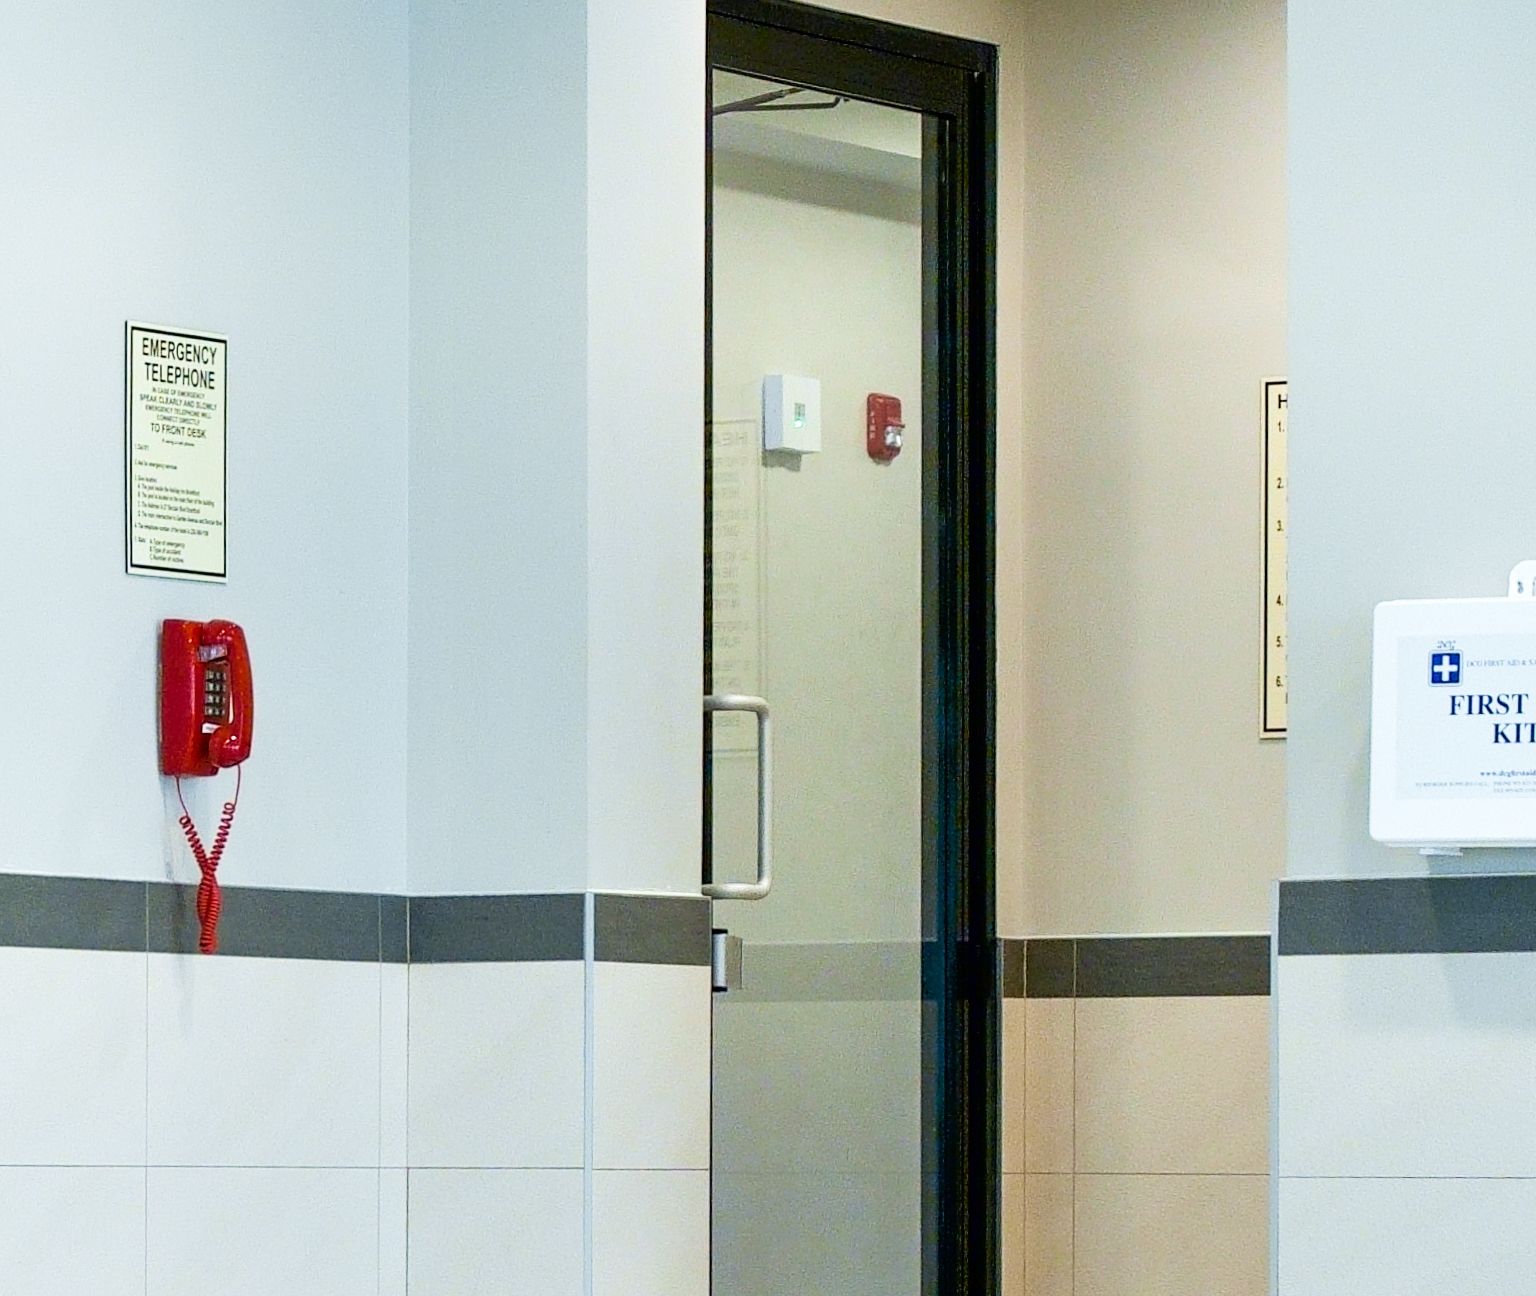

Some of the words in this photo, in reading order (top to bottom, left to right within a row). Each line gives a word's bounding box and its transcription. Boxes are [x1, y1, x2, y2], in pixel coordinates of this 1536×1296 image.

[142, 337, 217, 366] EMERGENCY
[144, 362, 215, 390] TELEPHONE
[162, 423, 185, 436] FRONT
[187, 427, 206, 439] DESK
[1449, 694, 1529, 716] FIRST
